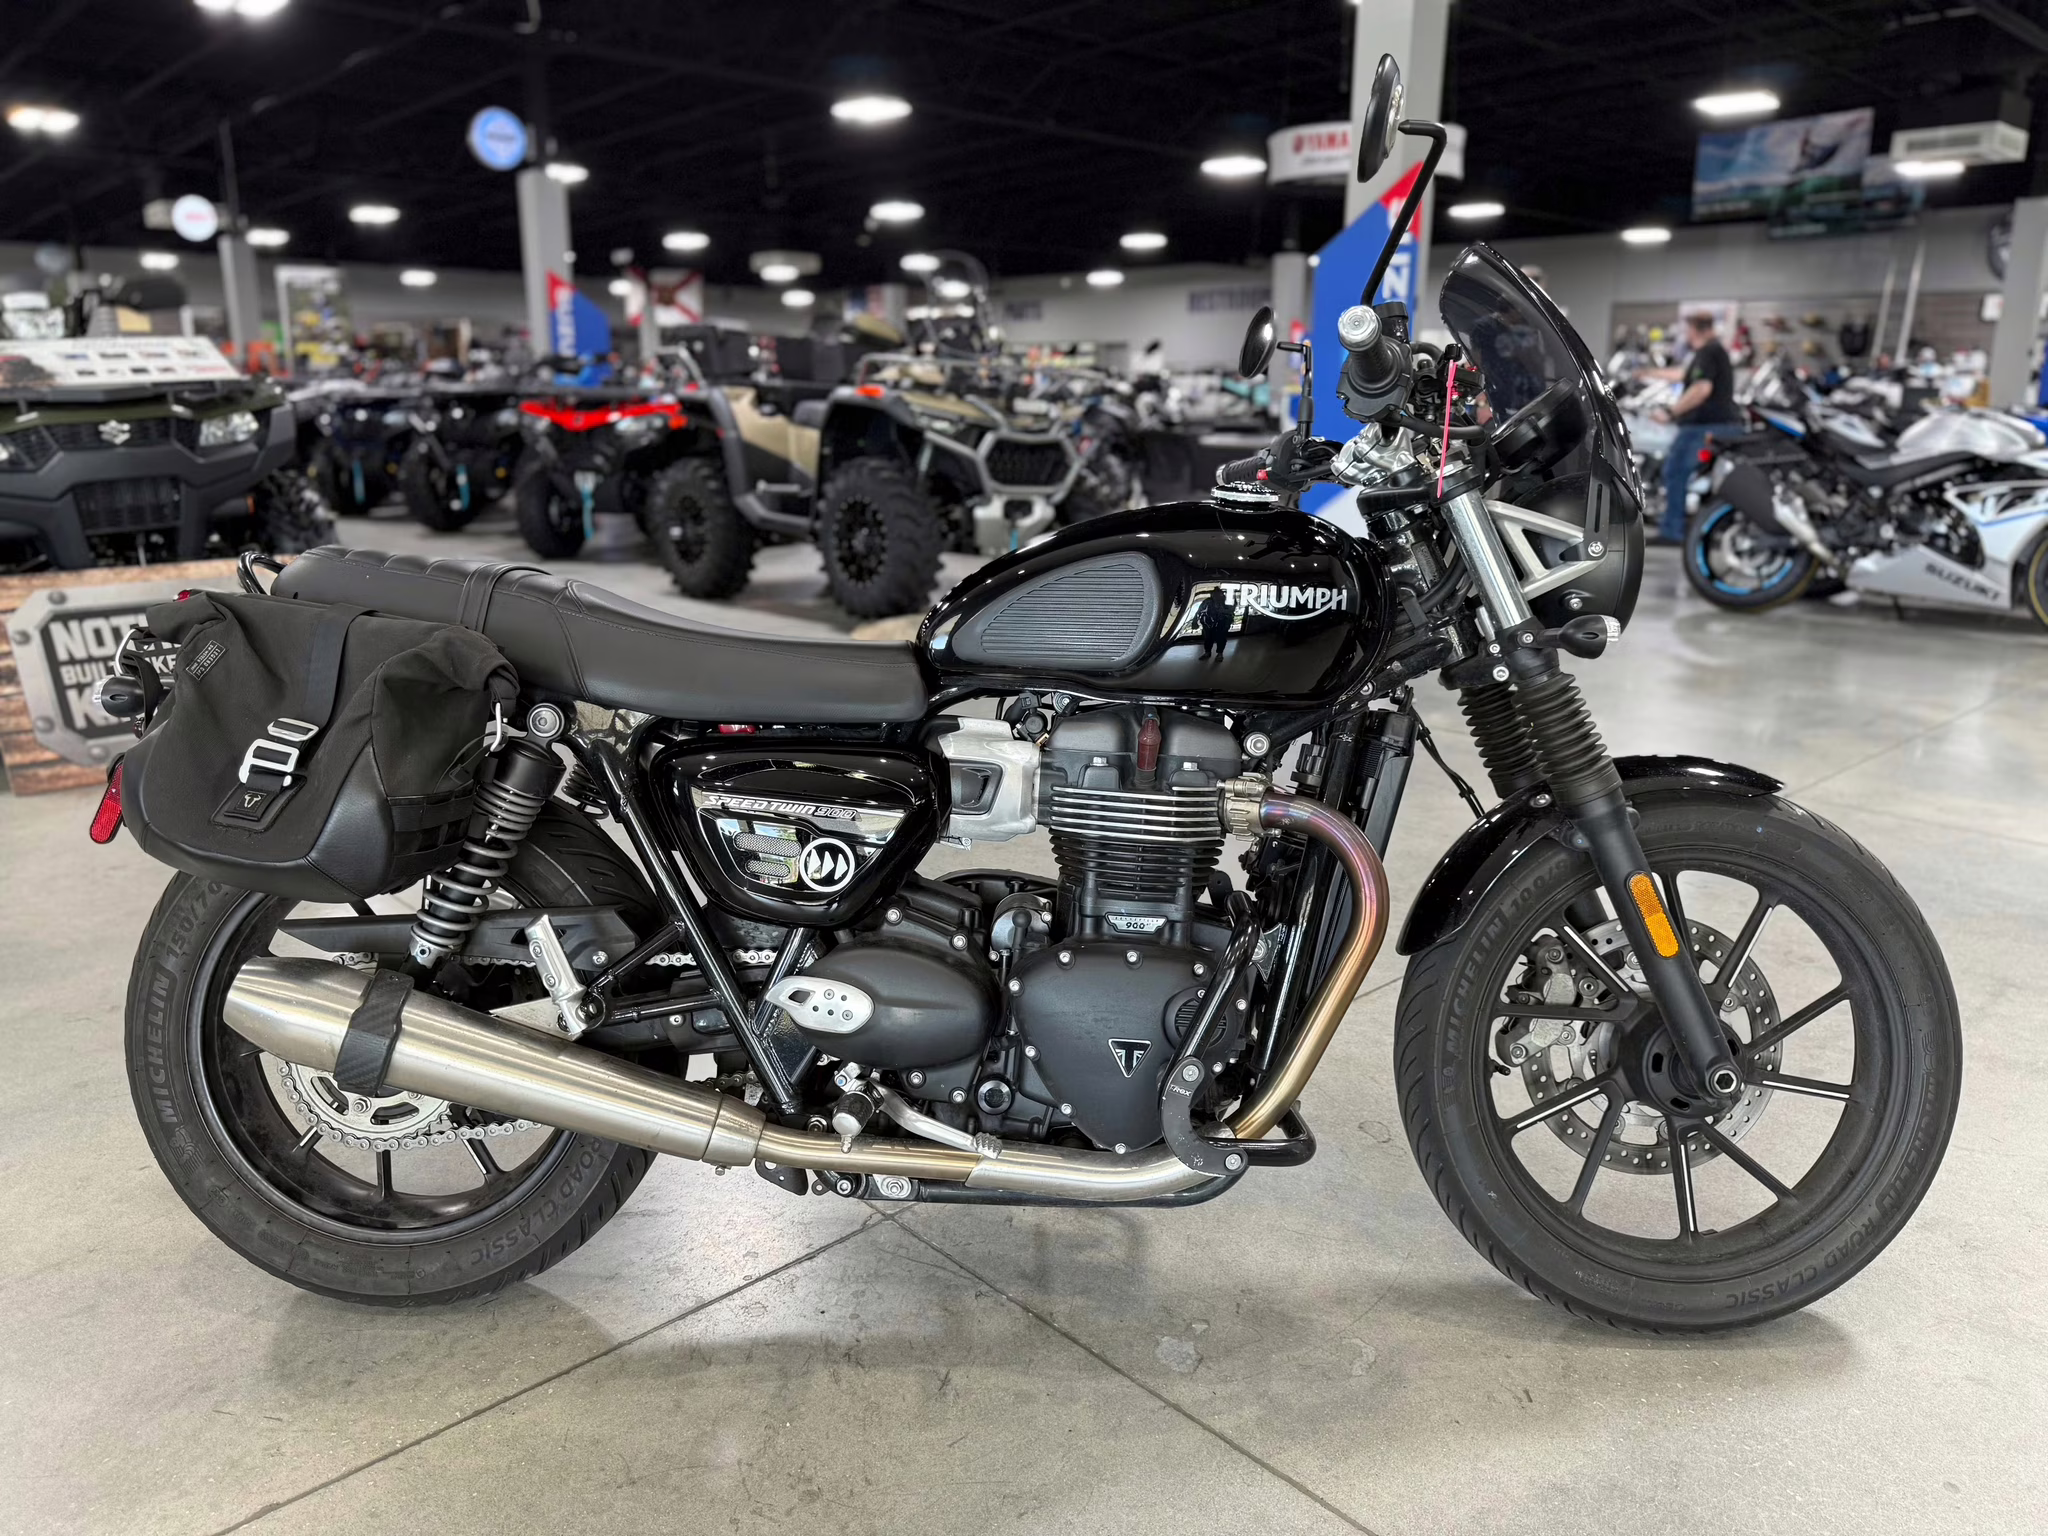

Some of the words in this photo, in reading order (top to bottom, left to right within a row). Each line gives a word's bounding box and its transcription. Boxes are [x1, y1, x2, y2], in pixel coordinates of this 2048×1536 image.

[1220, 583, 1347, 620] TRIUMPH
[704, 795, 768, 810] SPEED
[769, 801, 817, 815] TWIN
[813, 806, 857, 820] 900
[1125, 921, 1146, 930] 900
[1446, 917, 1507, 1053] MICHELIN
[148, 973, 178, 1124] MICHELIN
[559, 1136, 603, 1199] ROAD
[470, 1200, 558, 1266] CLASSIC
[1823, 1216, 1875, 1269] ROAD
[1725, 1265, 1818, 1309] CLASSIC
